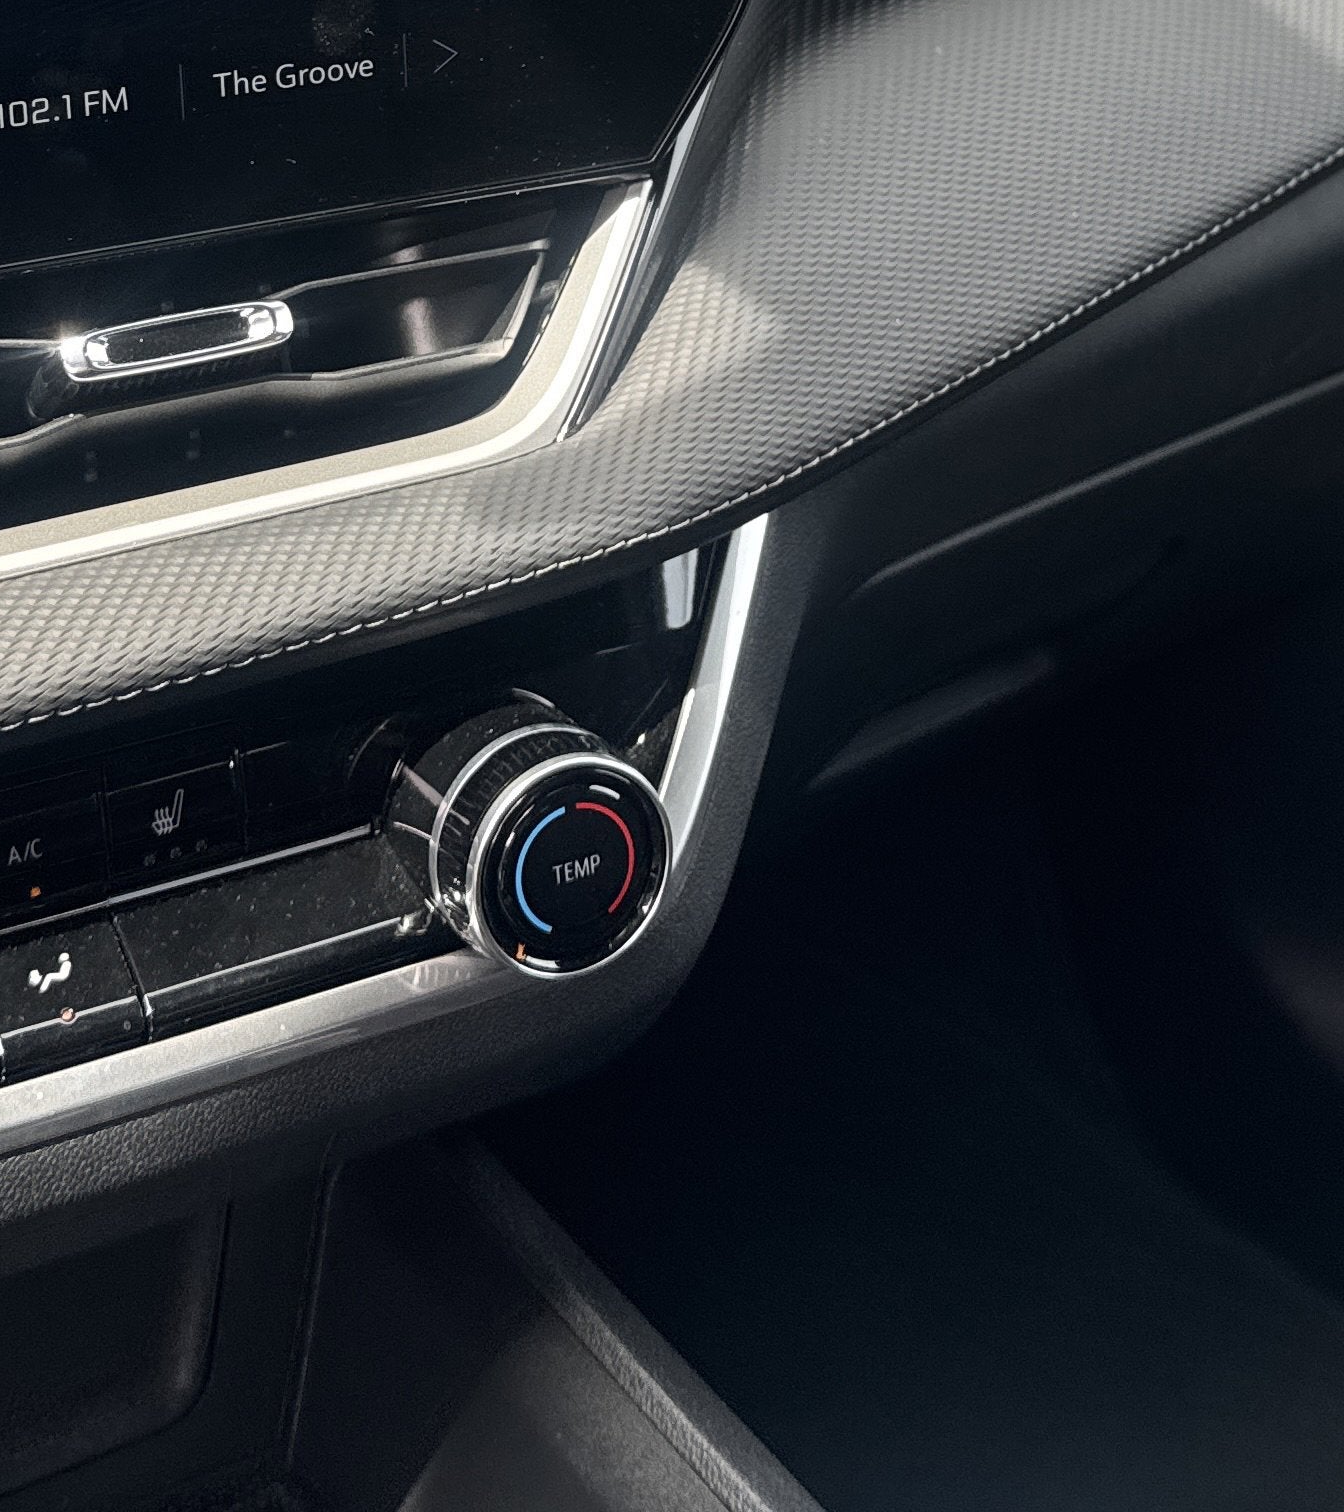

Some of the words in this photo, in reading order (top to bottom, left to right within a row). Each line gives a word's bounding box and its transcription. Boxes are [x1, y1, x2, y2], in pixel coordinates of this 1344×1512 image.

[211, 68, 268, 99] The
[274, 56, 375, 92] Groove
[82, 85, 129, 118] FM
[7, 837, 44, 866] A/C
[551, 853, 602, 885] TEMP
